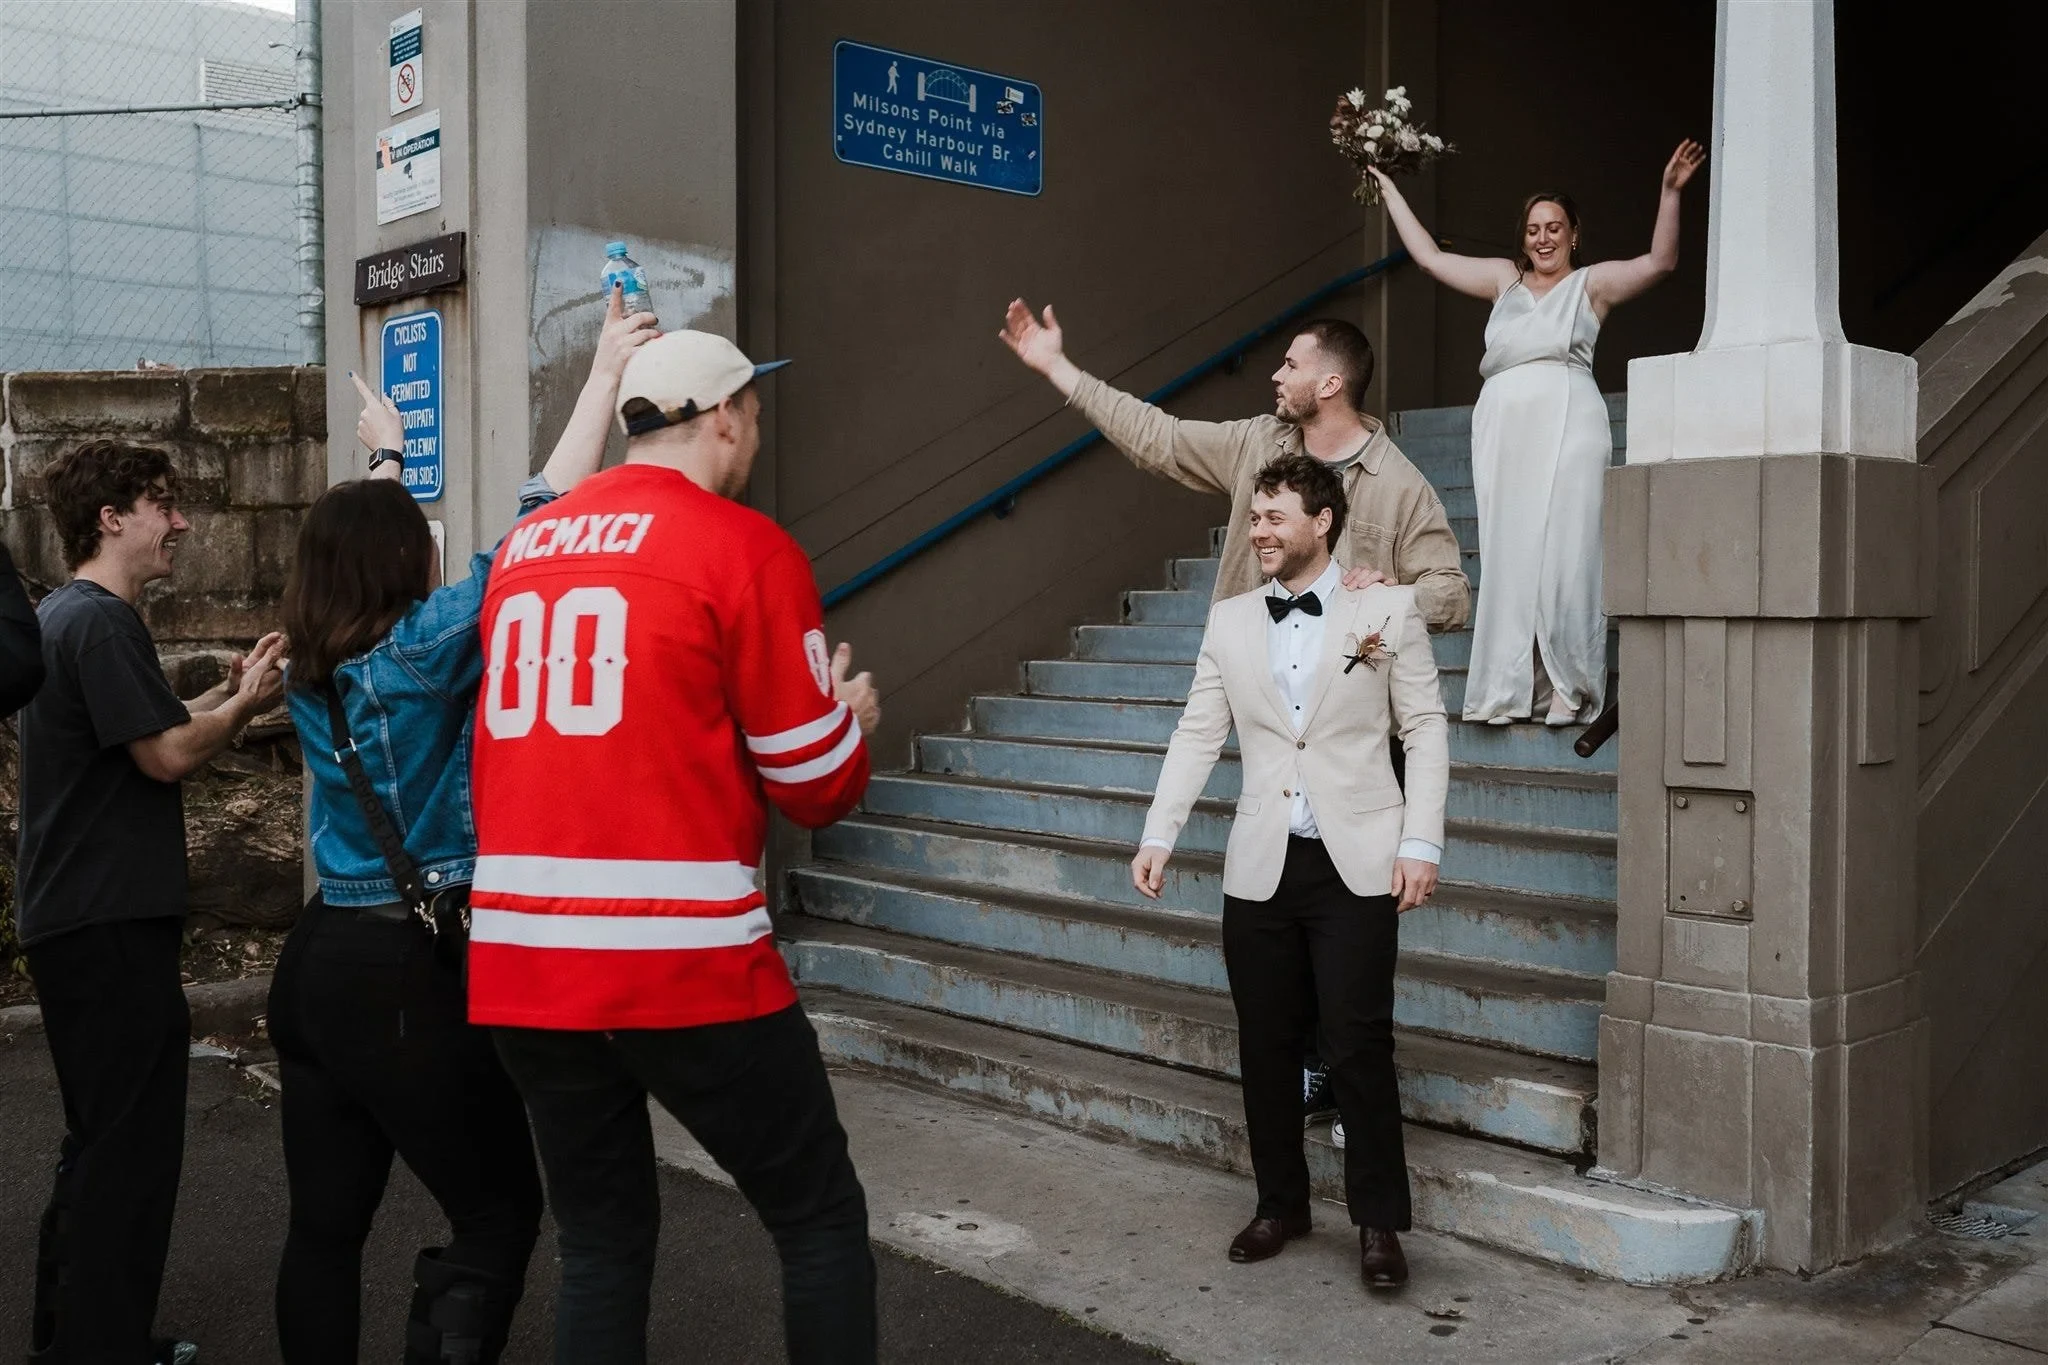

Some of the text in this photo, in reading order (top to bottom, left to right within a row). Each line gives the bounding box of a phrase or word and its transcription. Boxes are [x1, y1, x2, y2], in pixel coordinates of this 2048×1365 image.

[853, 92, 1005, 139] Milsons Point via
[403, 136, 435, 156] OPERATION
[844, 113, 1014, 163] Sydney Harbour Br.
[883, 144, 977, 176] Cahill Walk
[367, 249, 444, 290] Bridge Stairs
[394, 322, 427, 346] CYCLISTS
[403, 352, 417, 373] NOT
[391, 380, 430, 402] PERMITTED
[502, 513, 655, 569] MCMXCI
[485, 586, 629, 740] 00
